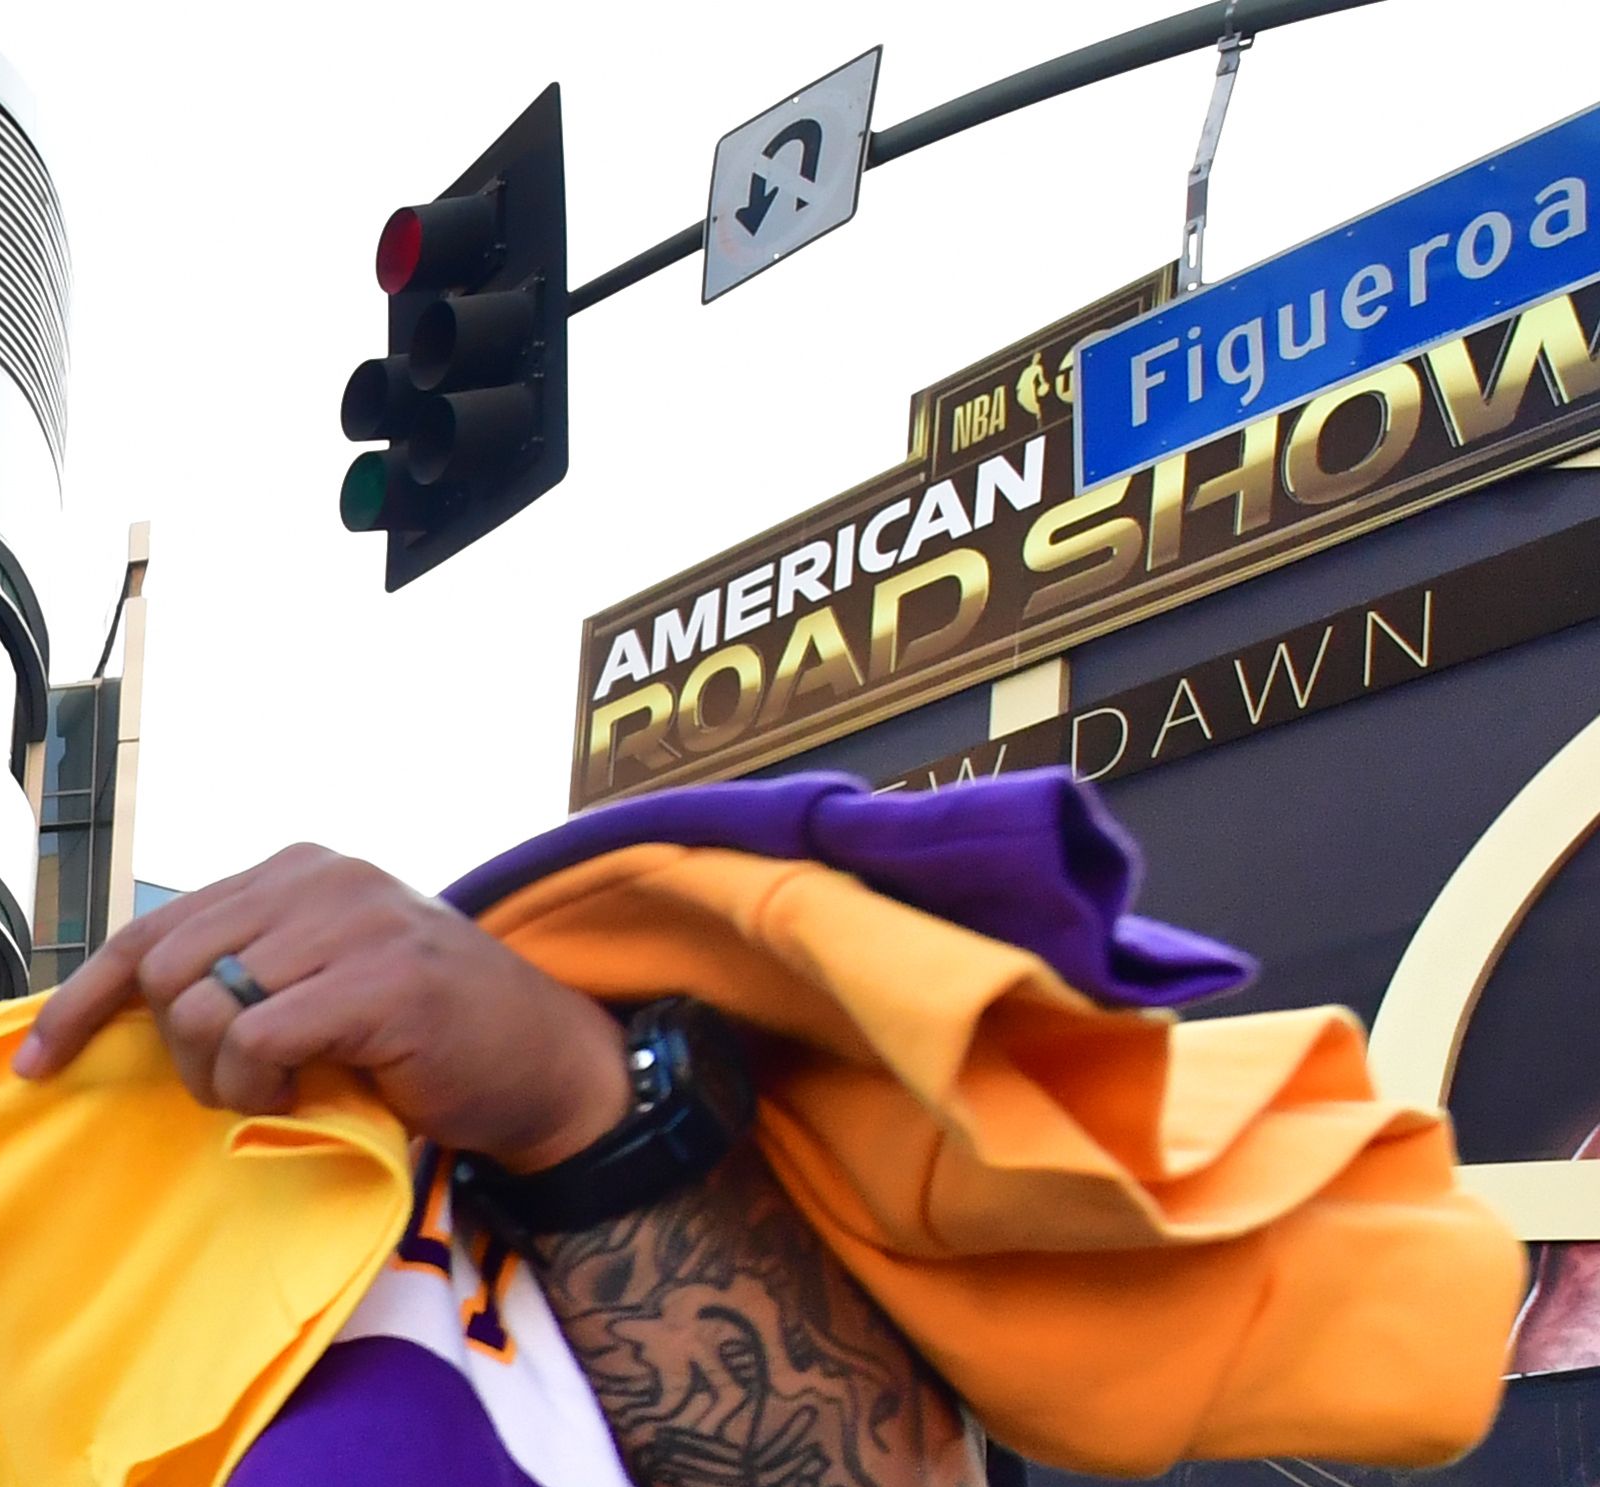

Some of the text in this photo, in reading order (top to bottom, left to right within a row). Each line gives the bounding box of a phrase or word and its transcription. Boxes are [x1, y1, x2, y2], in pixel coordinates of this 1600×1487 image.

[951, 385, 1006, 454] NBA
[1130, 176, 1587, 428] Figueroa
[586, 291, 1600, 787] ROAD SHOW
[593, 434, 1046, 700] AMERICAN
[1072, 590, 1432, 783] DAWN
